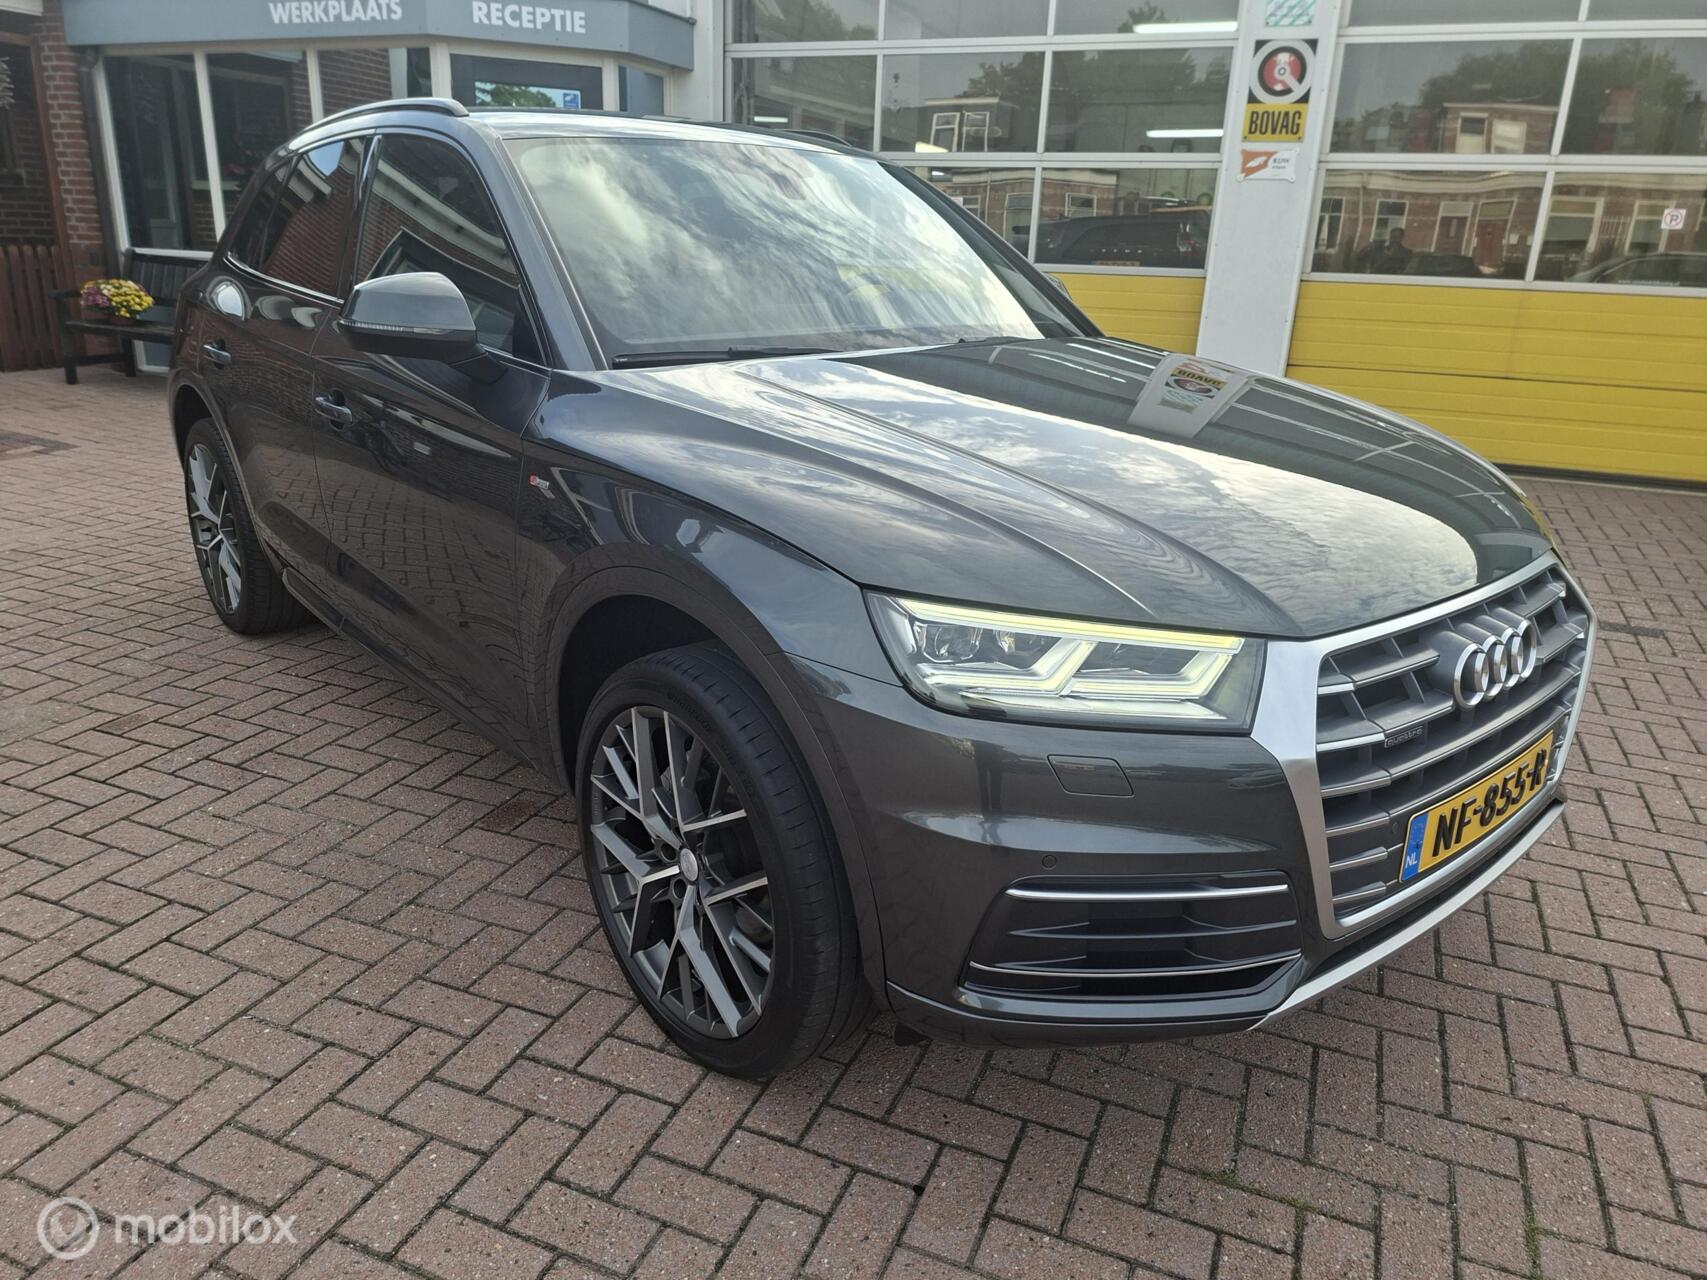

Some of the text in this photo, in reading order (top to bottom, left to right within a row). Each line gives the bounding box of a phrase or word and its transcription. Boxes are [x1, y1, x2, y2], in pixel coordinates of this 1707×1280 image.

[269, 0, 403, 25] WERKPLAATS
[472, 1, 587, 34] RECEPTIE
[1249, 111, 1302, 135] BOVAG
[1432, 749, 1547, 858] NF-855-R
[1405, 852, 1418, 868] NL
